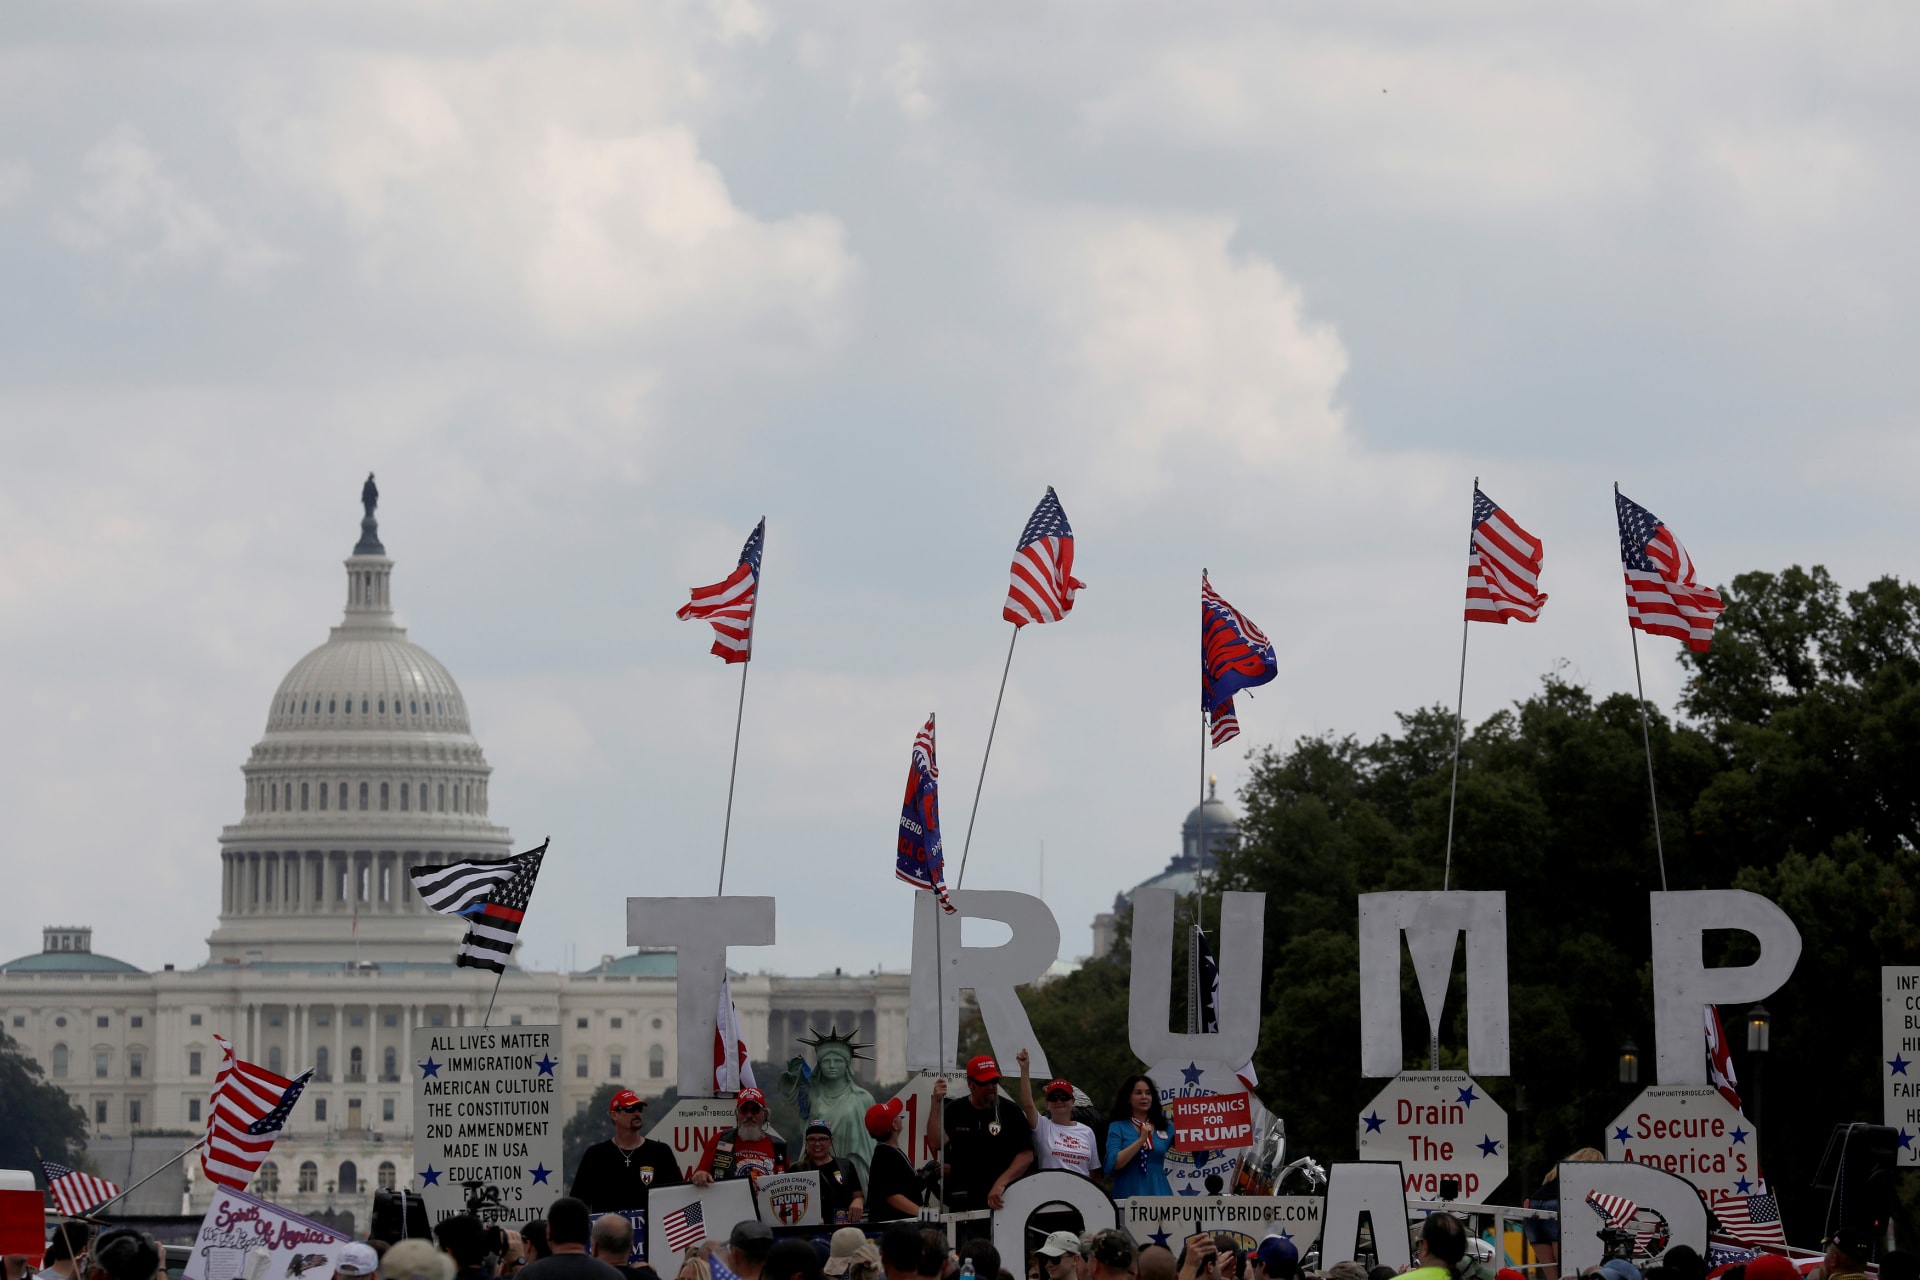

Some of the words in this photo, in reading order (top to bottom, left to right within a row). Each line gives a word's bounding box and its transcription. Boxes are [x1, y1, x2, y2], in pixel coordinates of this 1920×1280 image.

[431, 1037, 455, 1050] ALL
[460, 1035, 496, 1049] LIVES
[501, 1033, 550, 1049] MATTER
[448, 1056, 532, 1071] IMMIGRATION
[424, 1080, 490, 1096] AMERICAN
[496, 1079, 554, 1094] CULTURE
[1179, 1087, 1191, 1098] IN
[1647, 1090, 1715, 1098] TRUMPUNITYBRIDGE.COM
[428, 1103, 452, 1117] THE
[458, 1101, 549, 1116] CONSTITUTION
[1178, 1099, 1245, 1116] HISPANICS
[1397, 1099, 1464, 1125] Drain
[1203, 1115, 1224, 1125] FOR
[1637, 1113, 1725, 1140] Secure
[427, 1124, 453, 1139] 2ND
[458, 1122, 549, 1137] AMMENDMENT
[1176, 1124, 1251, 1143] TRUMP
[444, 1144, 479, 1158] MADE
[485, 1144, 497, 1157] IN
[503, 1143, 528, 1157] USA
[1408, 1136, 1454, 1161] The
[1624, 1147, 1748, 1174] America's
[450, 1166, 522, 1181] EDUCATION
[1176, 1170, 1187, 1179] &
[1192, 1159, 1236, 1179] ORDER
[761, 1178, 790, 1193] MINNESOTA
[792, 1177, 817, 1188] CHAPTER
[770, 1185, 793, 1195] BIKERS
[773, 1194, 806, 1206] TRUMP
[1130, 1206, 1318, 1221] TRUMPUNITYBRIDGE.COM
